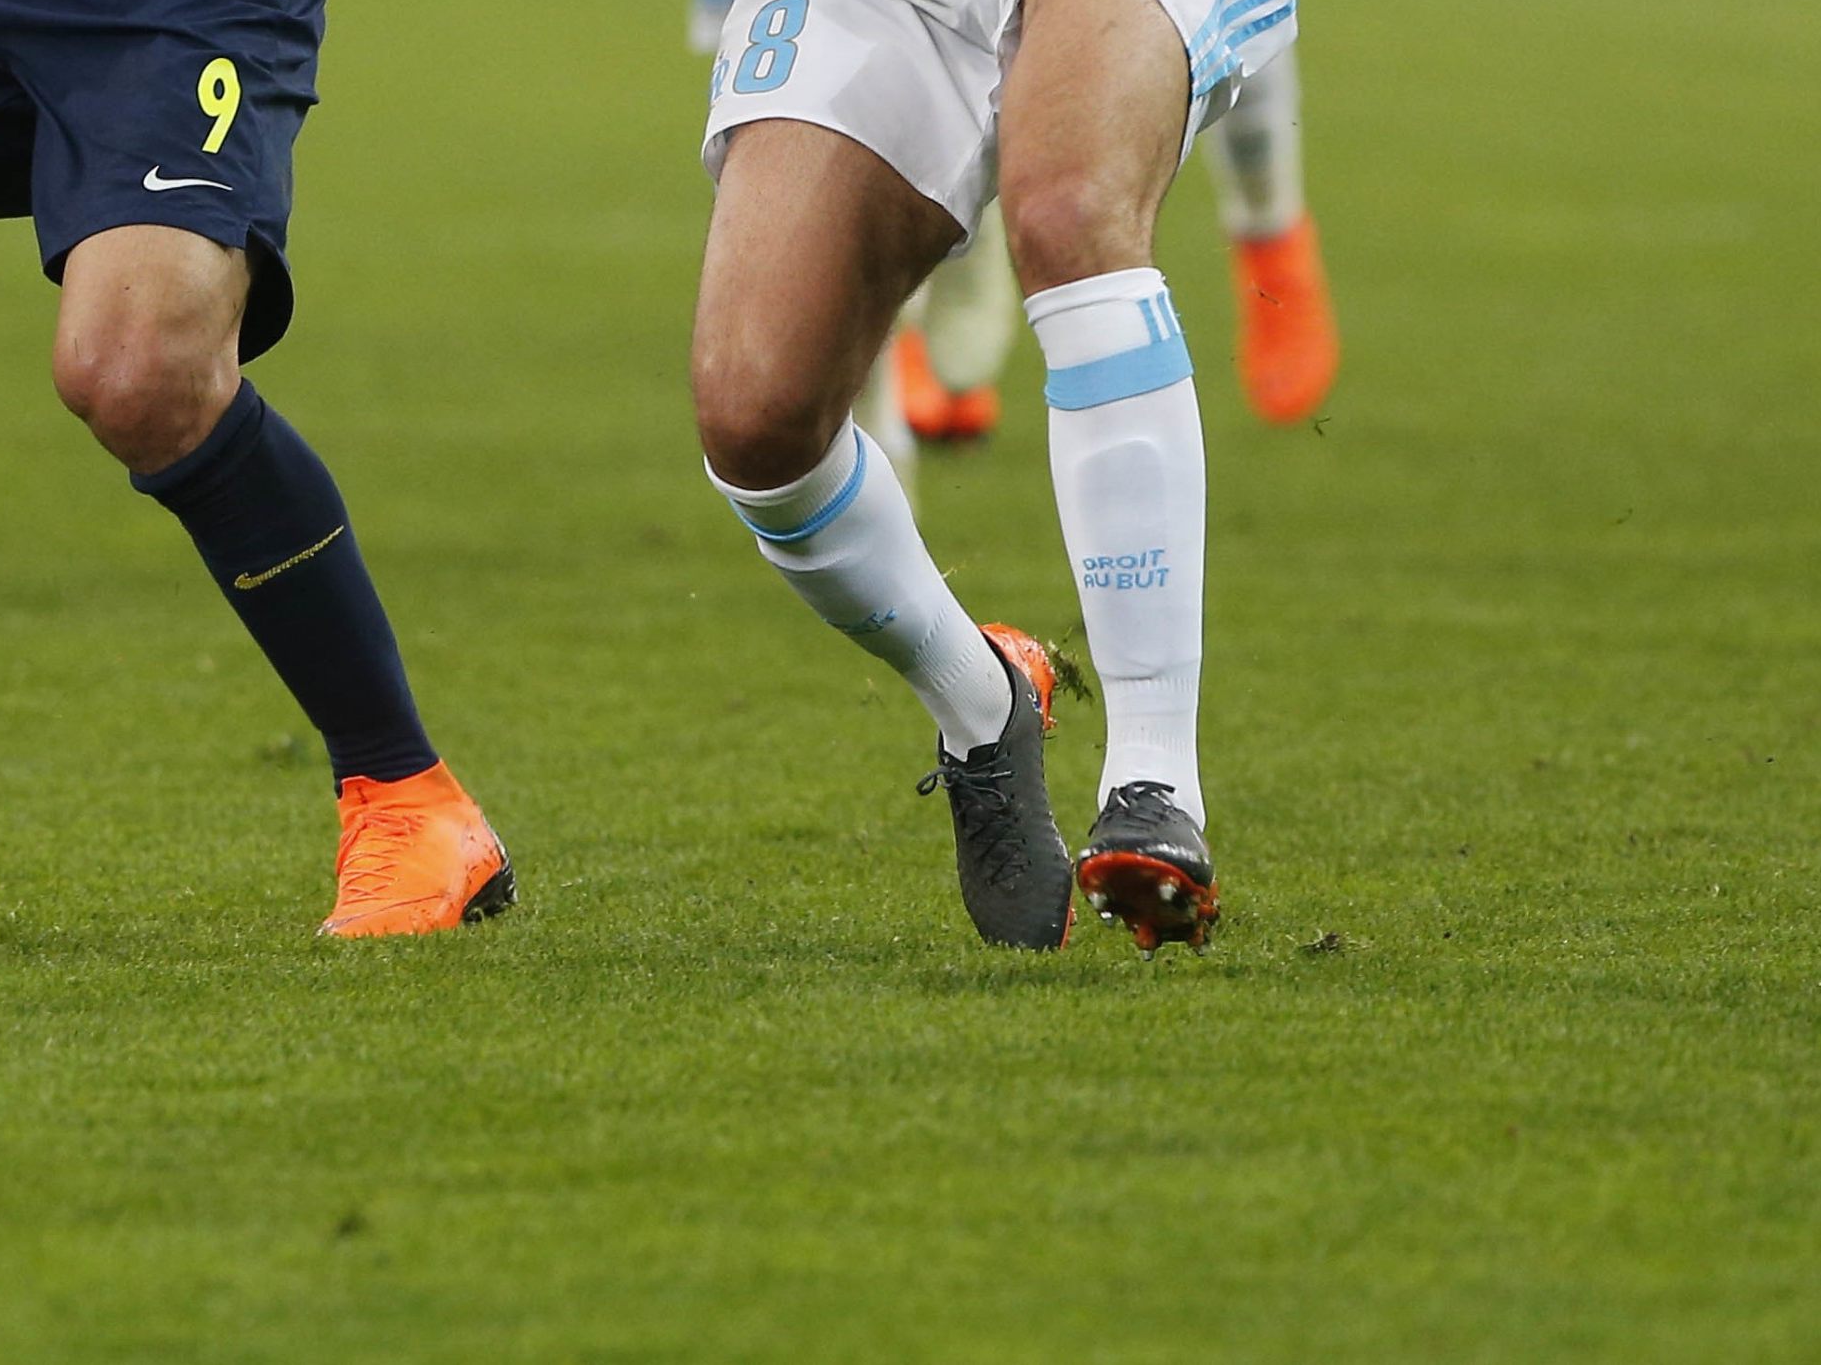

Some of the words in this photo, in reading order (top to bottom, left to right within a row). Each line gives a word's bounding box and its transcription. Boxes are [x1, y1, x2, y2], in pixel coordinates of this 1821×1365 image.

[197, 57, 242, 154] 9
[1083, 549, 1165, 571] DROIT
[1084, 572, 1109, 589] AU
[1117, 568, 1169, 590] BUT
